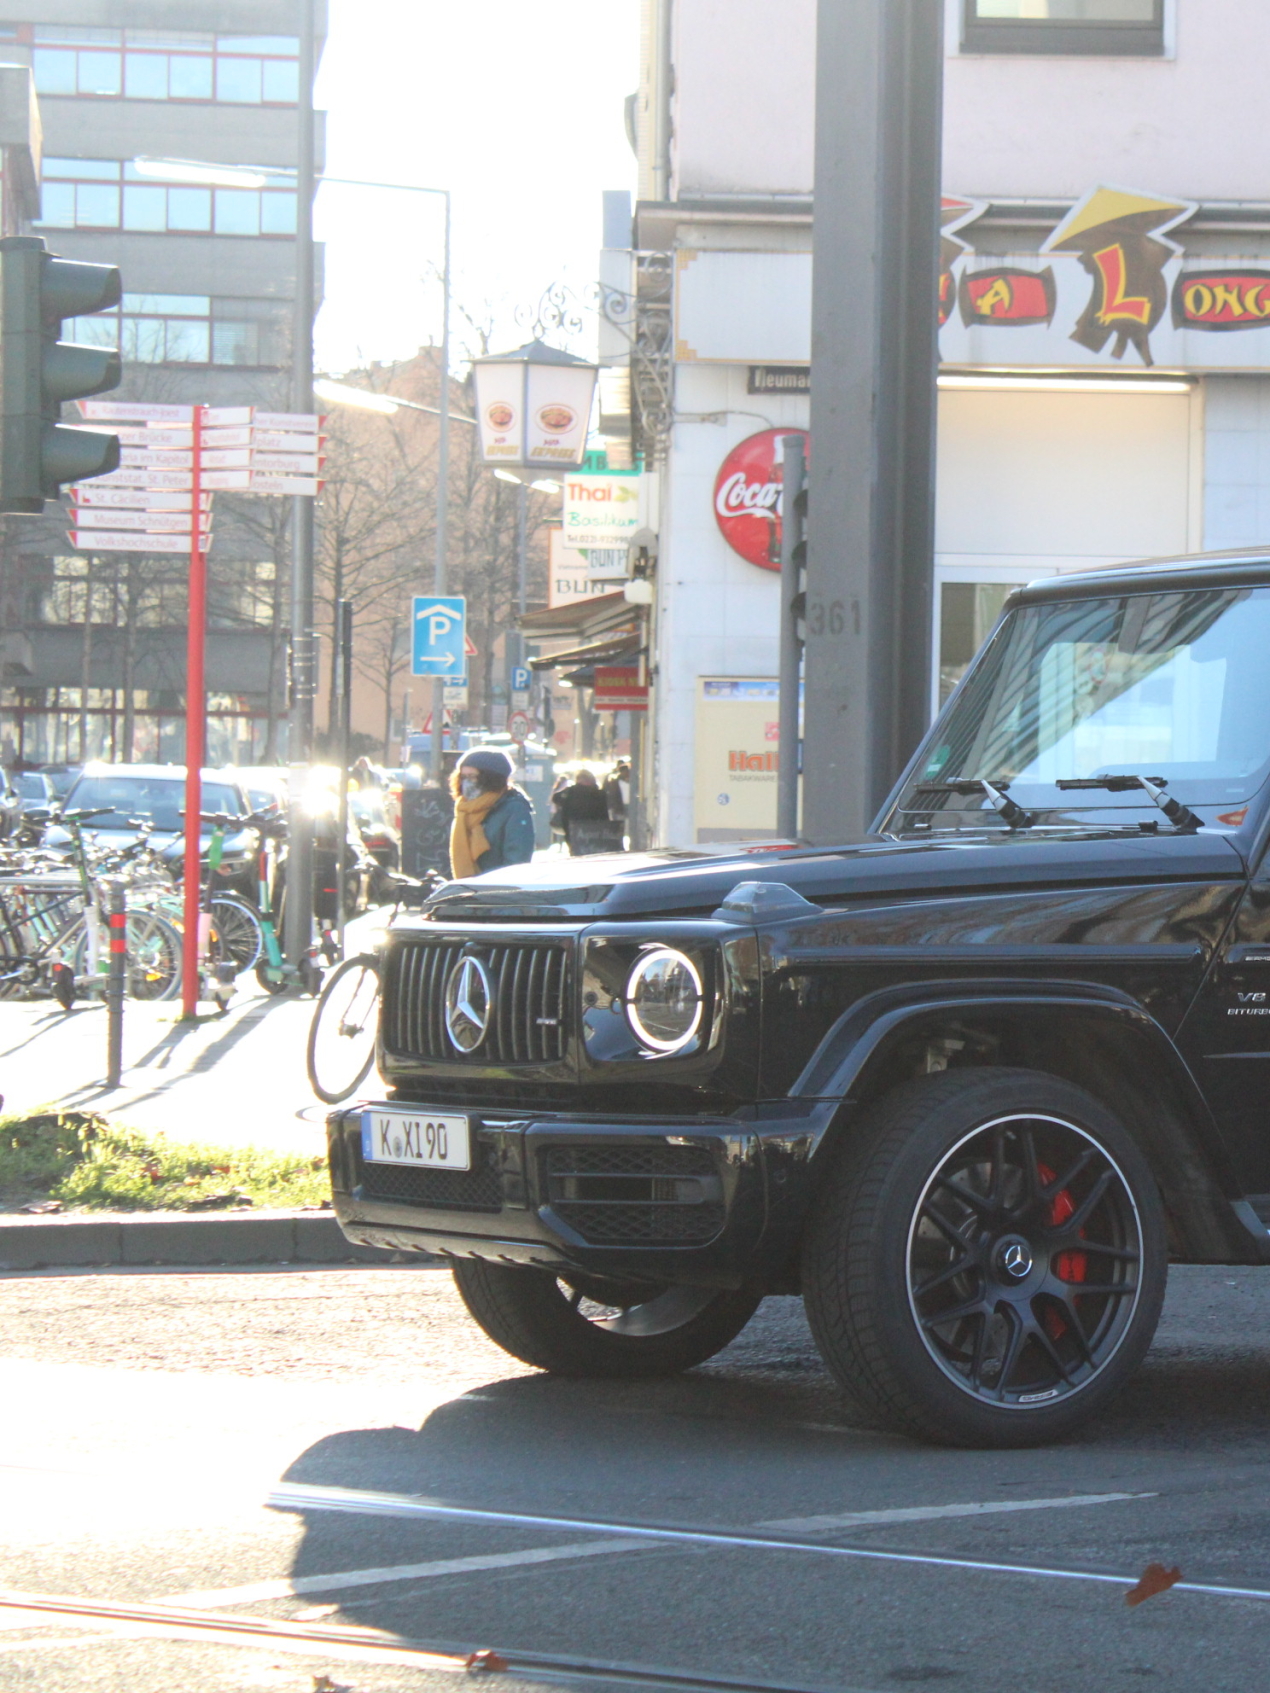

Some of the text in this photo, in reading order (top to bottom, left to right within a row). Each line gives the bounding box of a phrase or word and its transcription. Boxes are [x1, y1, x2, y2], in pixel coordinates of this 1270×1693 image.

[156, 453, 189, 466] Kapitol
[567, 483, 612, 502] Thai
[94, 514, 188, 530] Museum Schnütgen
[567, 511, 638, 527] Basilikum
[94, 535, 179, 549] Volkshochschule
[810, 599, 861, 635] 361
[429, 616, 452, 646] P
[515, 668, 528, 688] P
[1237, 992, 1267, 1002] V8
[380, 1119, 392, 1156] K
